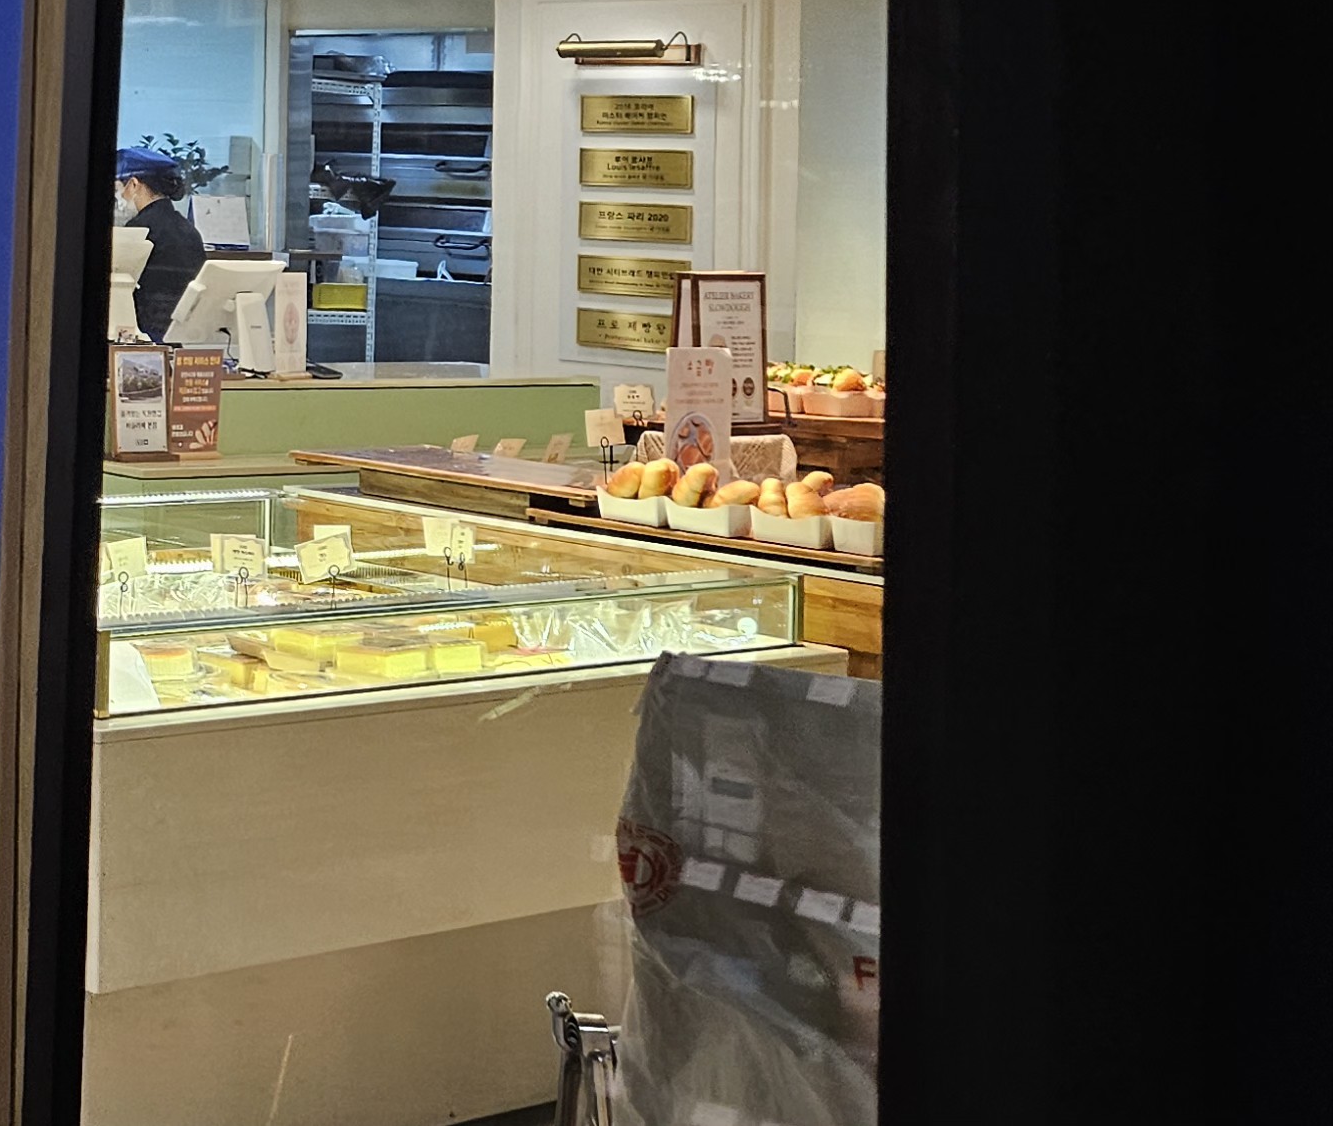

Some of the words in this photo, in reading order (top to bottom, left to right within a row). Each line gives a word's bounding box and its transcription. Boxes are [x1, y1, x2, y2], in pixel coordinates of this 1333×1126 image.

[598, 211, 624, 221] 프랑스
[627, 212, 645, 222] 파리
[647, 212, 670, 223] 2020
